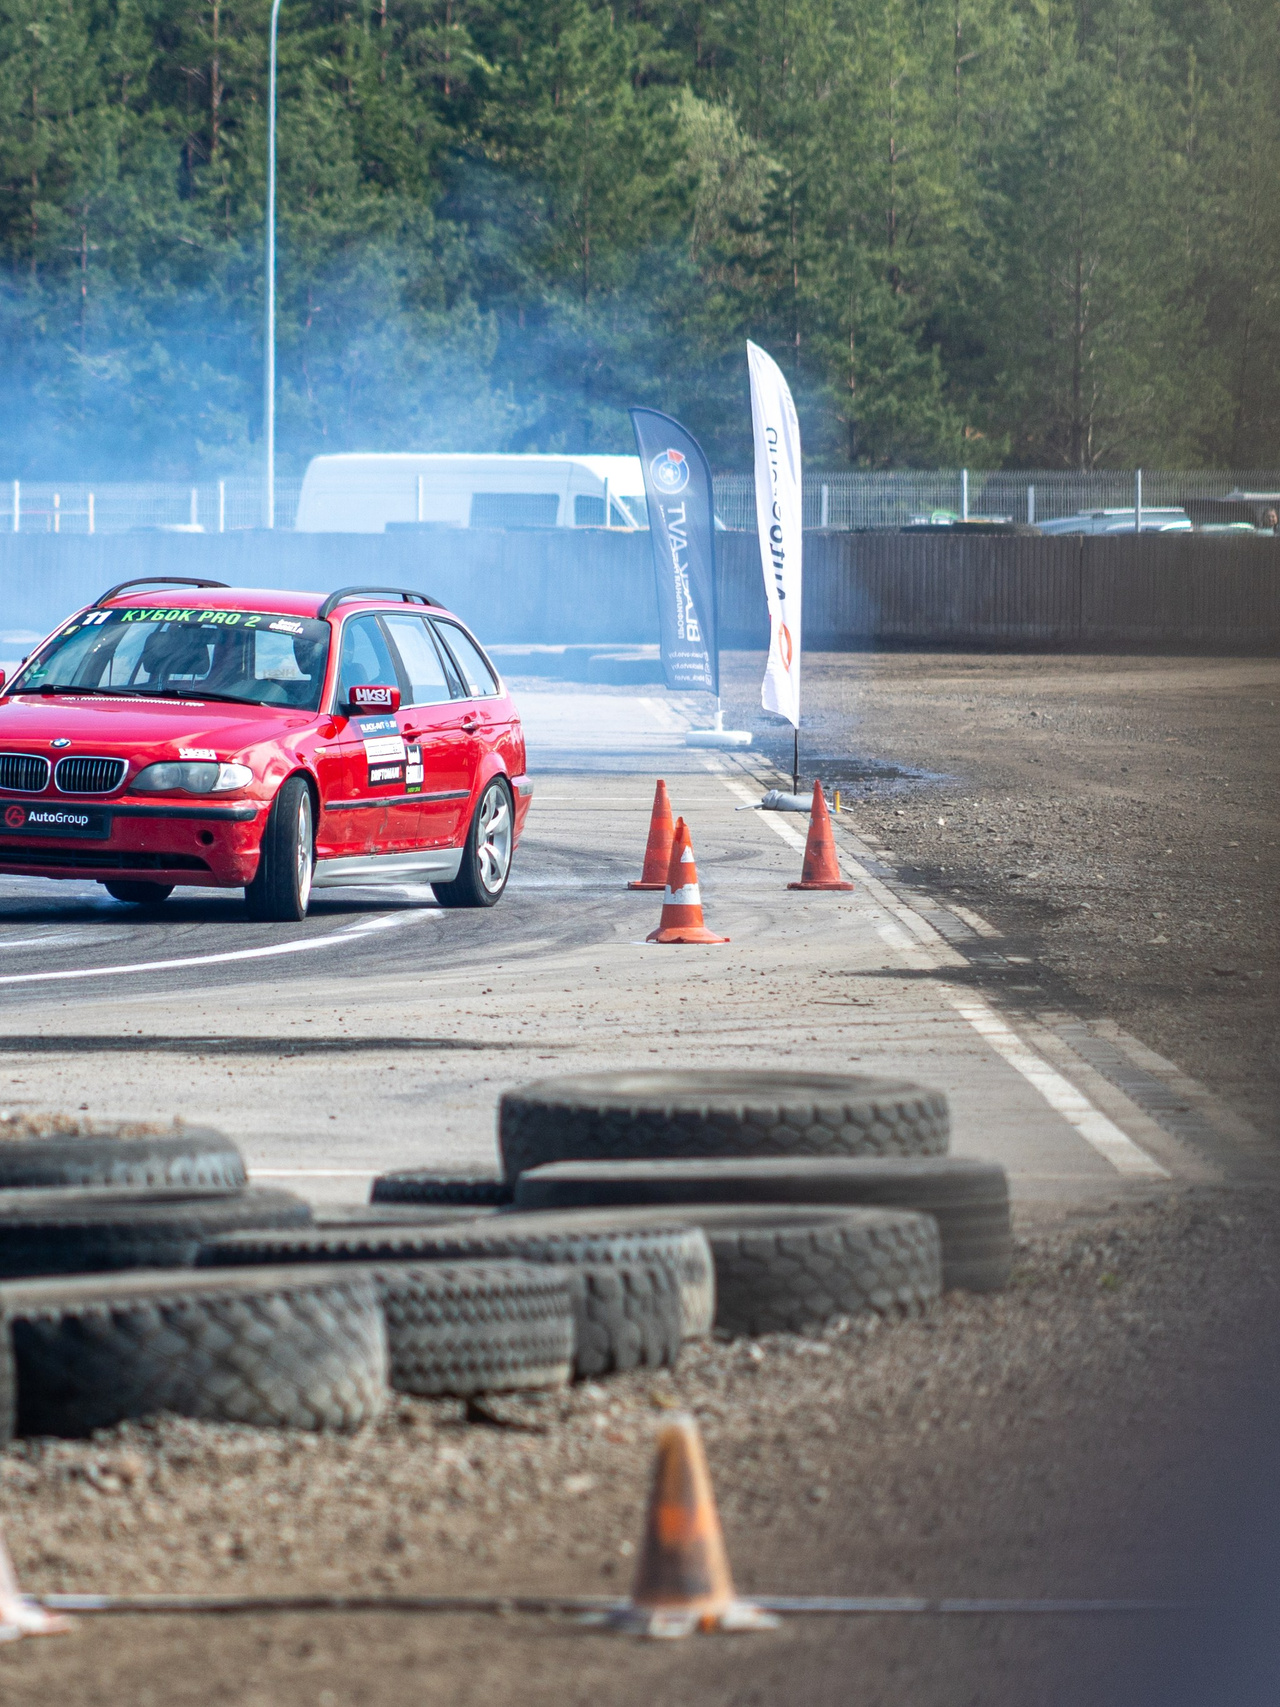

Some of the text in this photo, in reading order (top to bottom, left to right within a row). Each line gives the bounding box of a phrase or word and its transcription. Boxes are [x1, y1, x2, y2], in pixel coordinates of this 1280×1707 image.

[82, 610, 114, 625] 11
[121, 609, 196, 622] КУБОК
[197, 612, 242, 625] PRO
[244, 616, 262, 628] 2
[28, 810, 89, 826] AutoGroup
